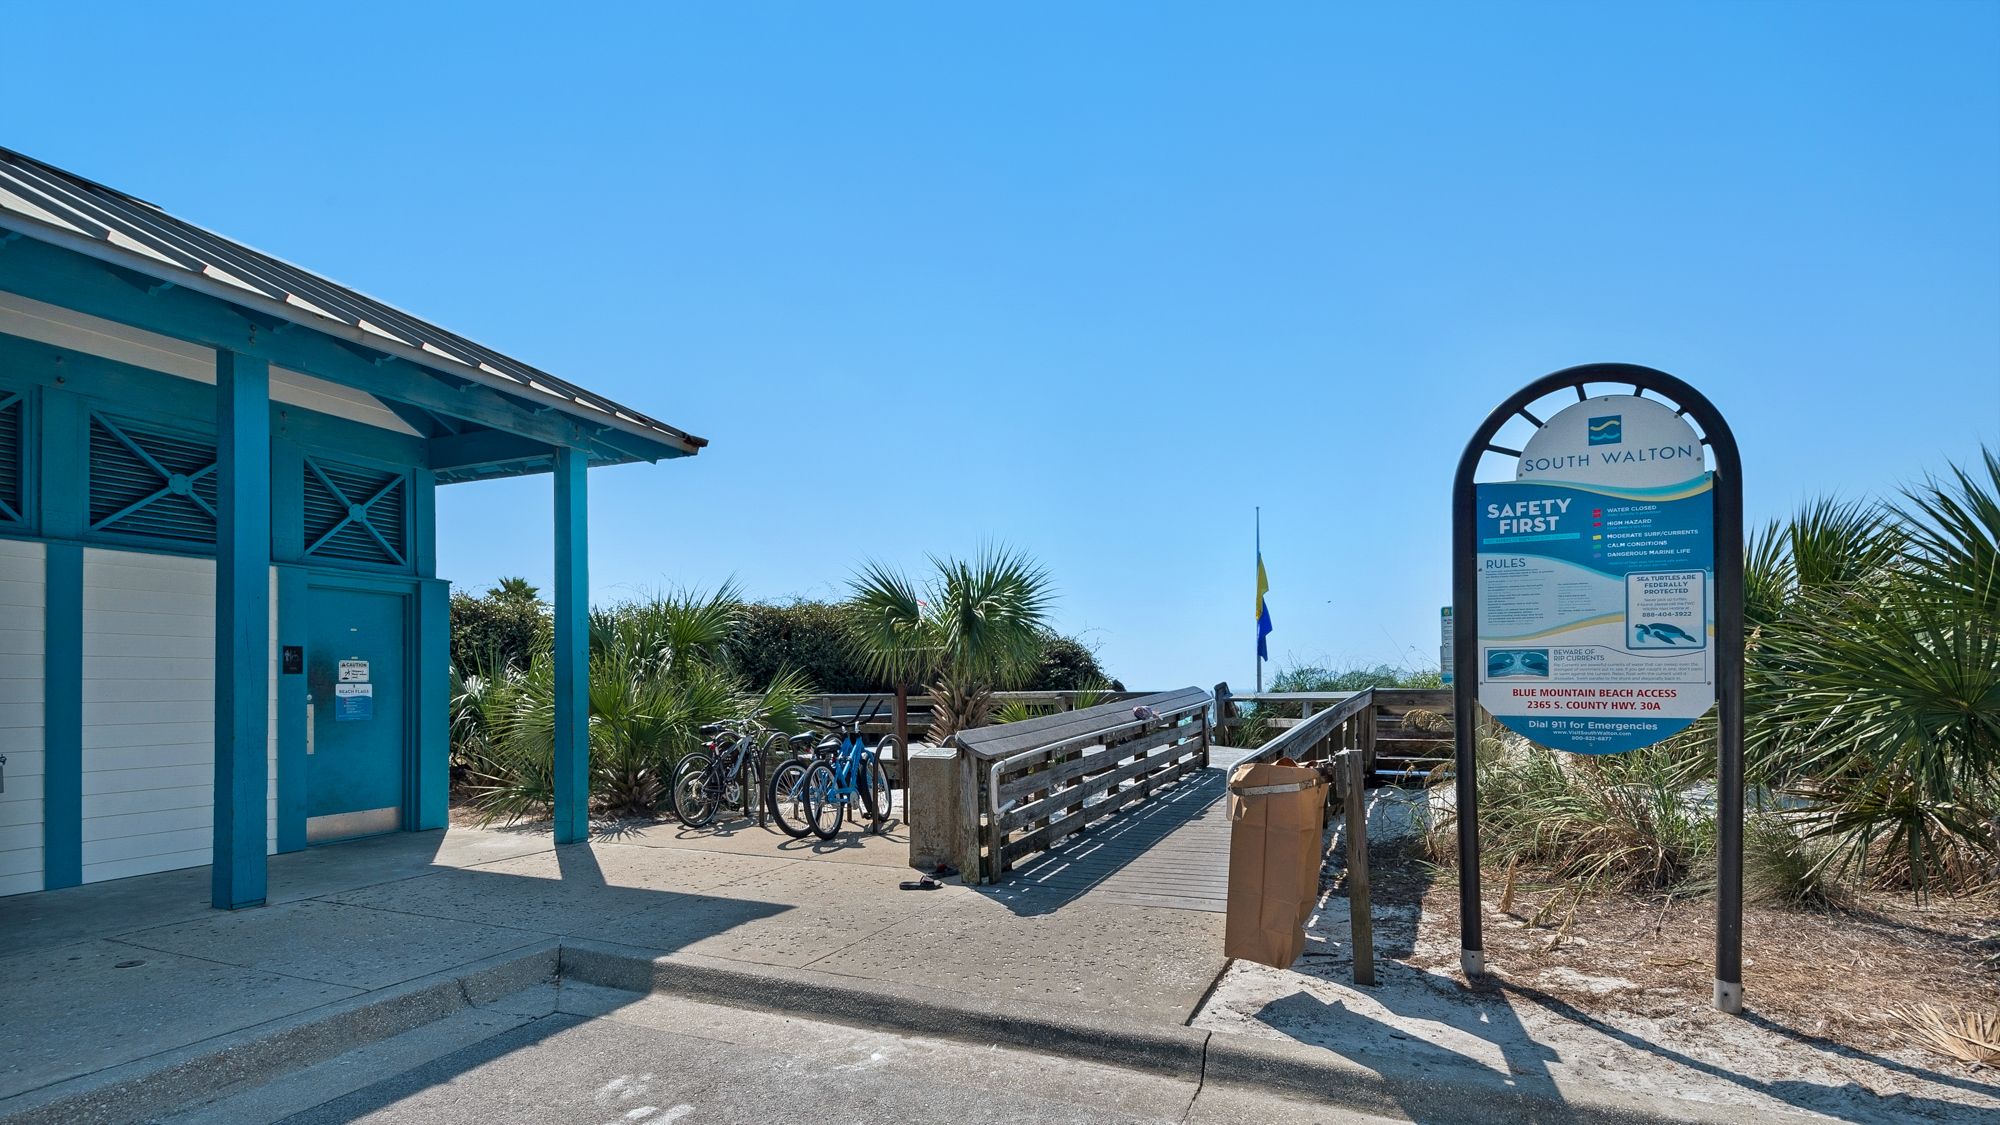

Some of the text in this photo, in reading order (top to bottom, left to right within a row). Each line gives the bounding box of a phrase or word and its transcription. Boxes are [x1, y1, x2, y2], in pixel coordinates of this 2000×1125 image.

[1525, 445, 1692, 472] SOUTH WALTON
[1488, 498, 1571, 518] SAFETY
[1500, 516, 1559, 534] FIRST
[1644, 529, 1698, 537] SURF/CURRENTS
[1486, 558, 1526, 569] RULES
[1637, 689, 1676, 697] ACCESS
[1640, 702, 1660, 710] 30A
[1588, 722, 1658, 730] Emergencies
